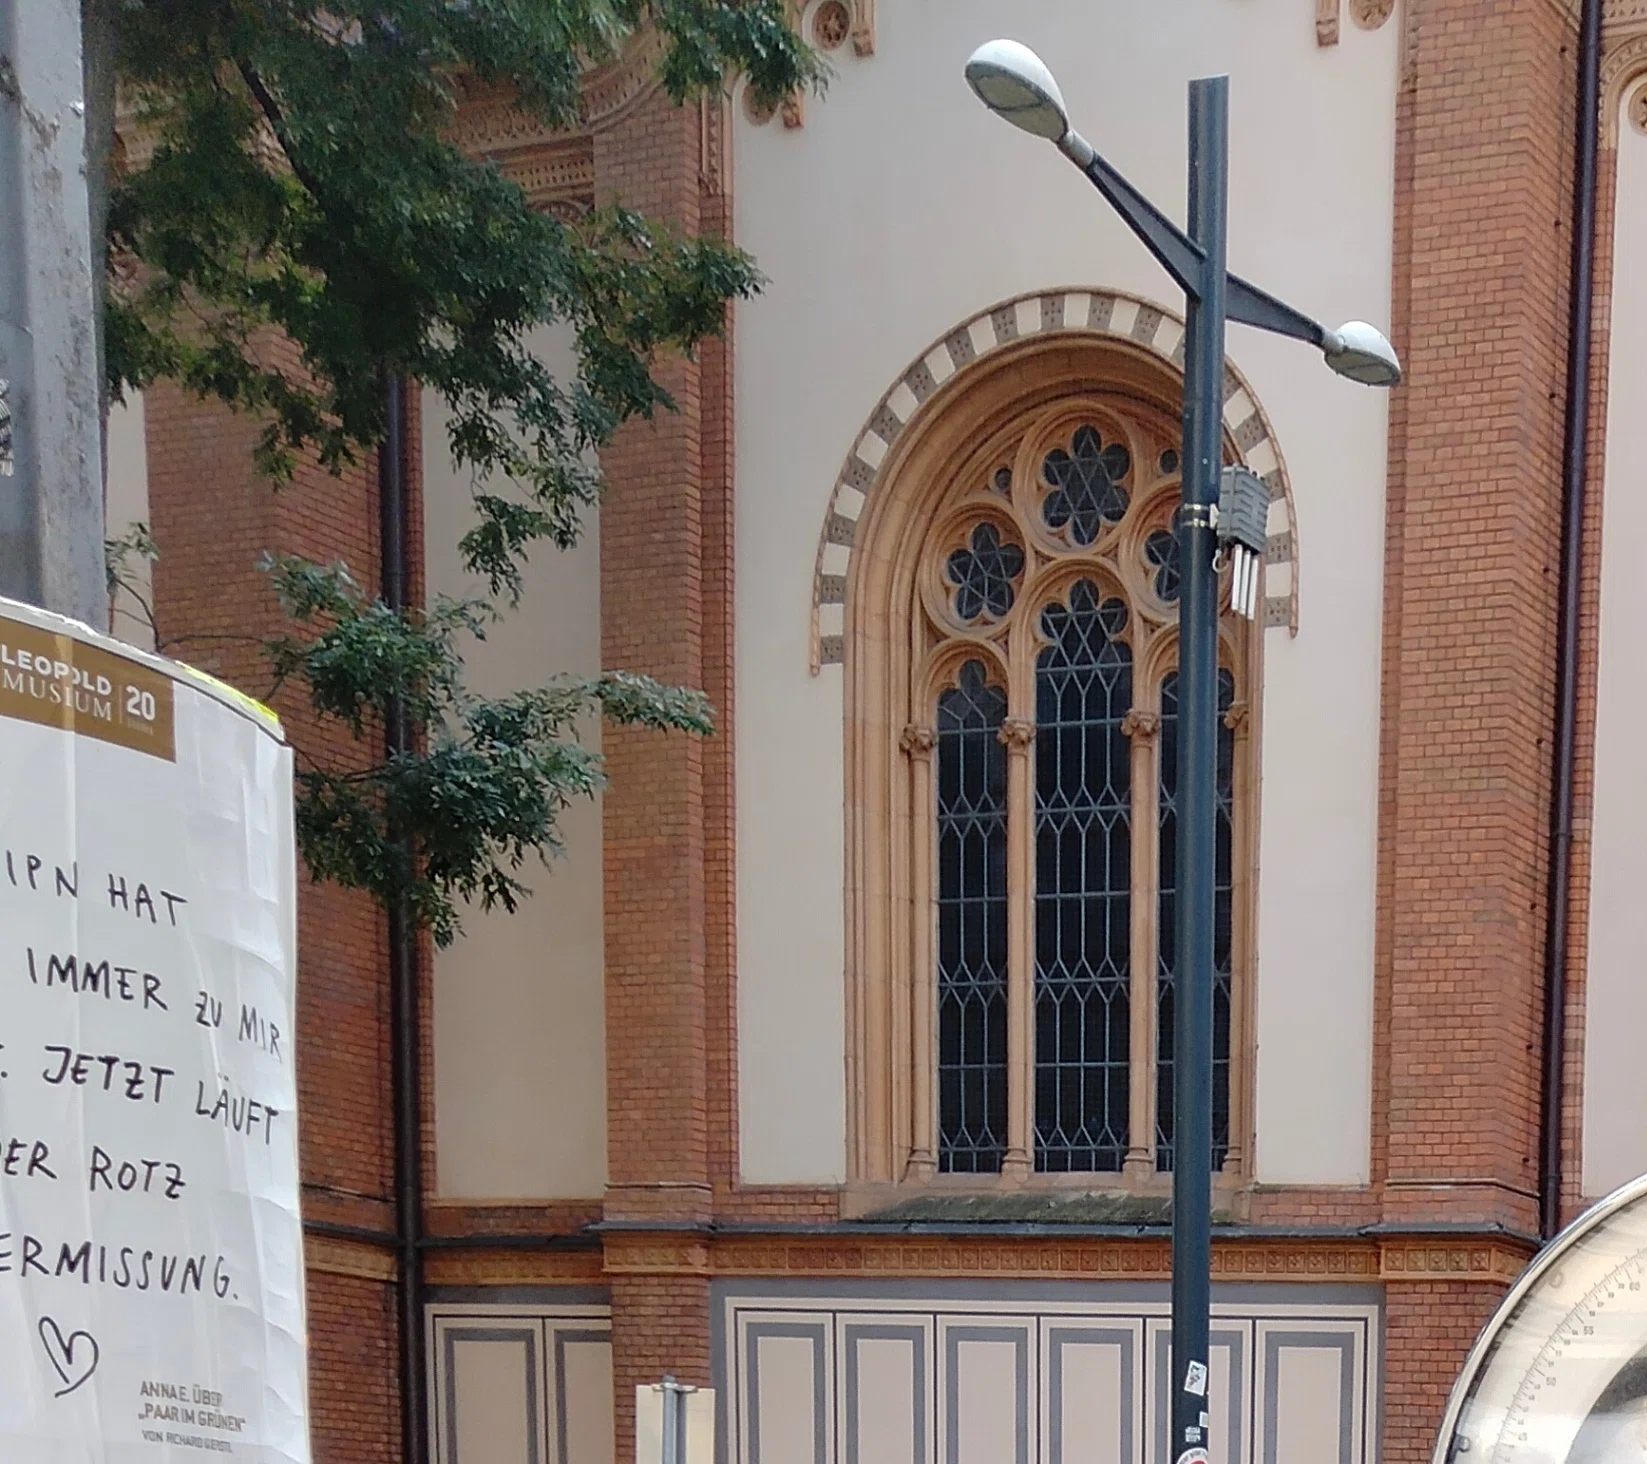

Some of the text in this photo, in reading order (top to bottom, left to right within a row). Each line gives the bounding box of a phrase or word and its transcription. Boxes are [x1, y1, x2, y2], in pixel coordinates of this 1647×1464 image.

[126, 685, 156, 721] 20
[107, 873, 188, 926] HAT
[27, 947, 282, 1064] IMMER ZU MIR
[43, 1045, 175, 1103] JETZT
[196, 1072, 279, 1146] LÄUFT
[90, 1145, 187, 1199] ROTZ
[140, 1380, 177, 1399] ANNA
[192, 1384, 223, 1407] ÜBER
[142, 1430, 163, 1443] VON
[181, 1408, 195, 1424] IM
